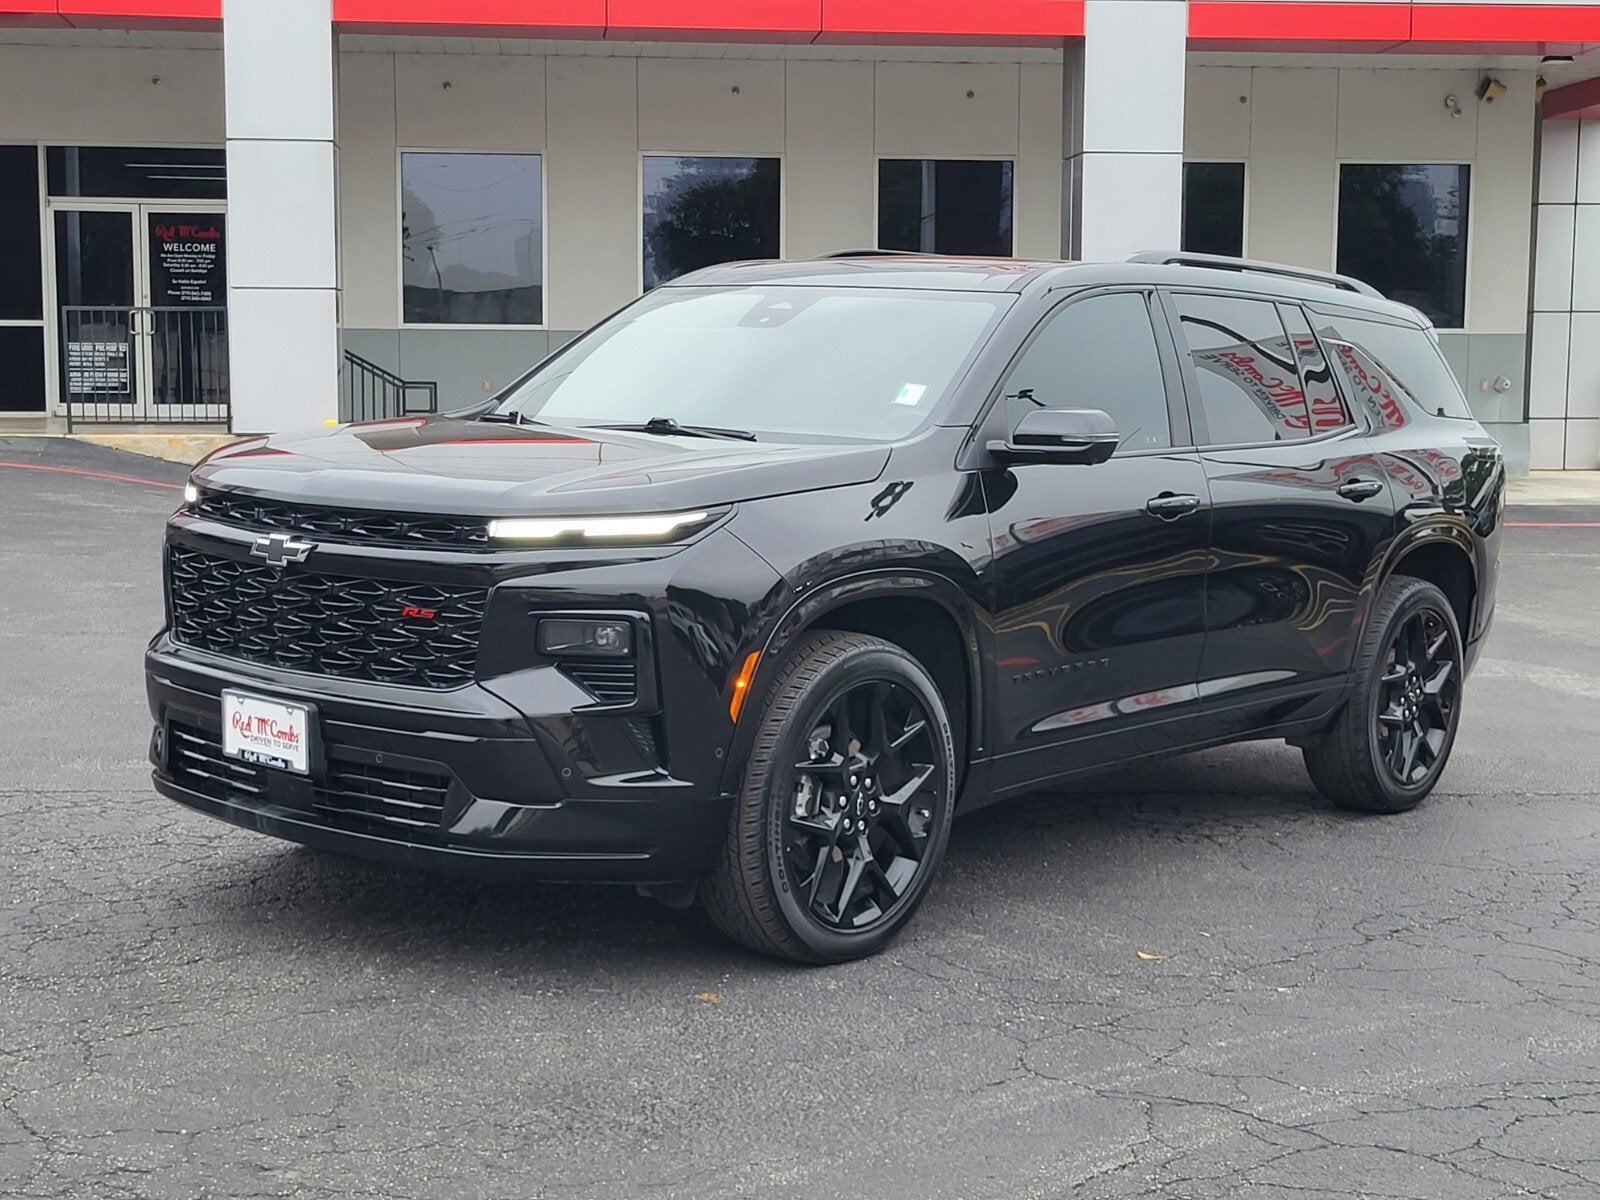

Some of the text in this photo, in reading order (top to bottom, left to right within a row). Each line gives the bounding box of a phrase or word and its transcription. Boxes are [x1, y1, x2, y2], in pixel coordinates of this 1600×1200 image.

[163, 243, 216, 252] WELCOME
[401, 606, 435, 618] RS
[232, 710, 300, 744] Red McCombs
[250, 735, 272, 746] DRIVEN
[282, 742, 300, 752] SERVE
